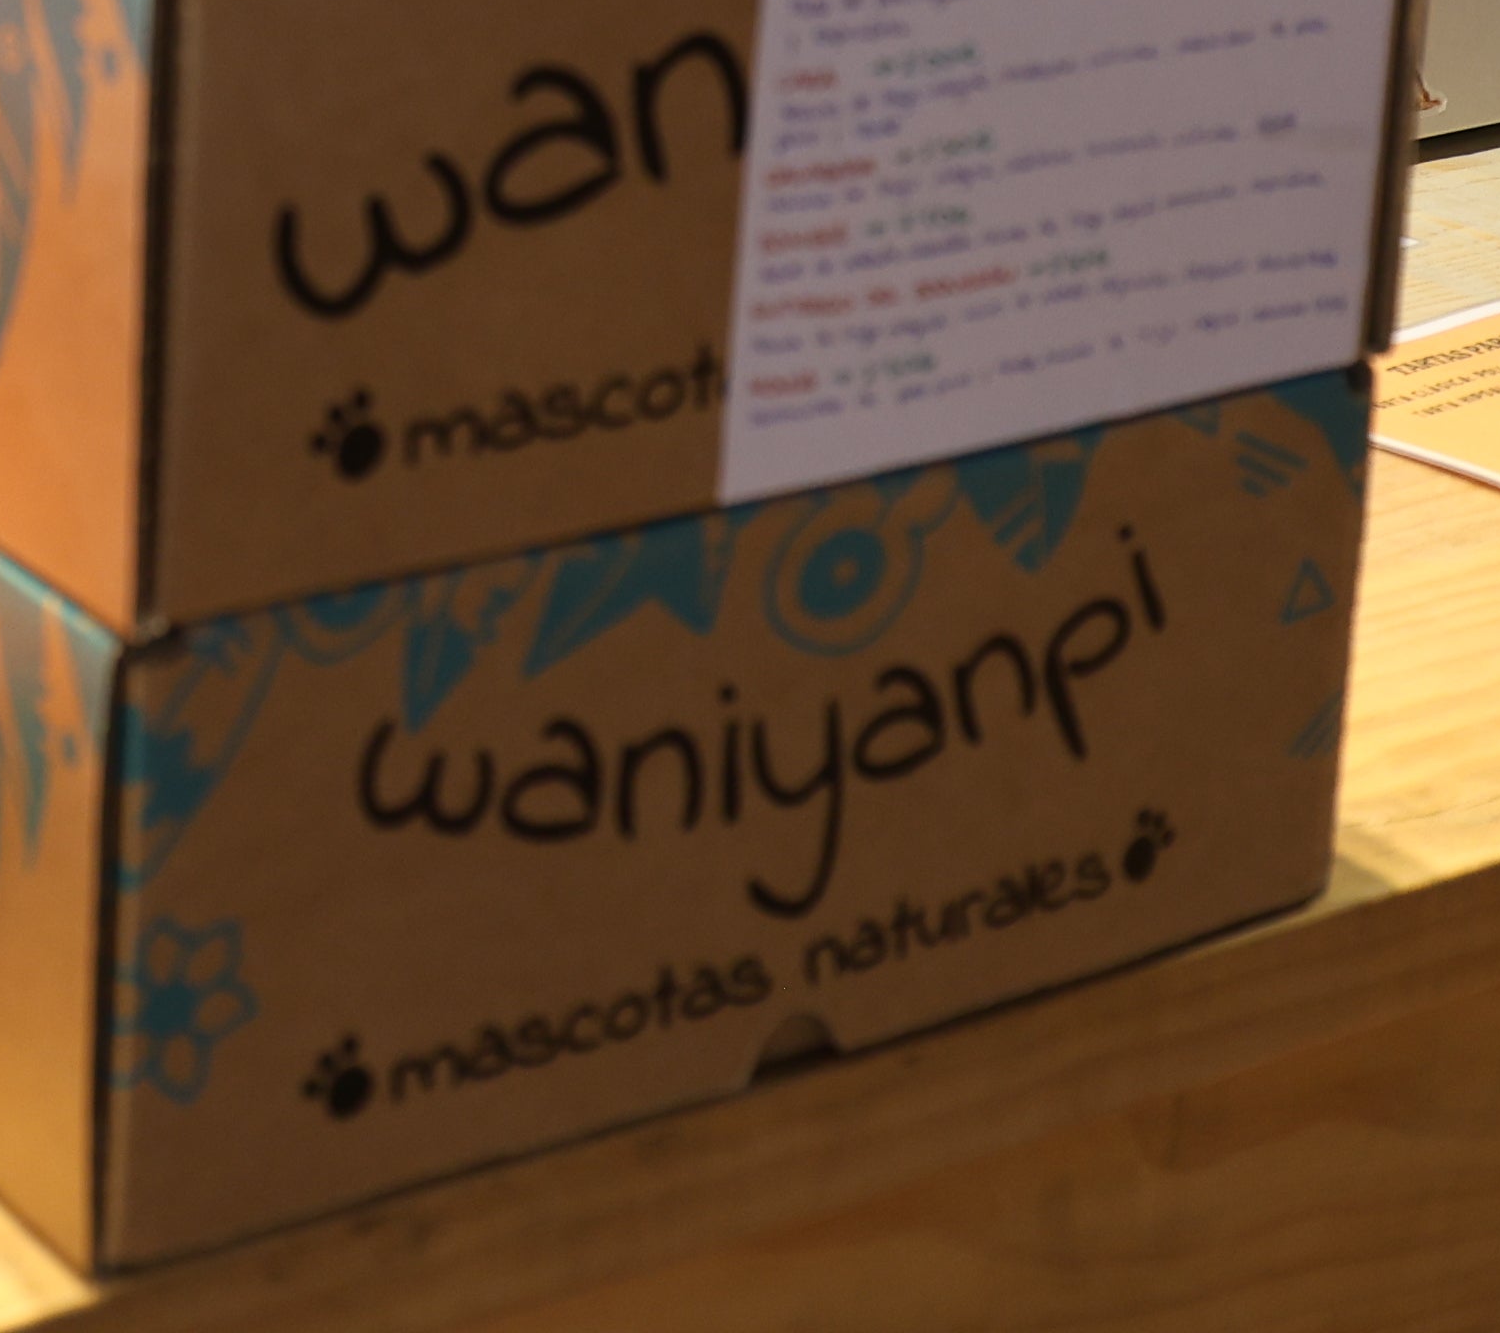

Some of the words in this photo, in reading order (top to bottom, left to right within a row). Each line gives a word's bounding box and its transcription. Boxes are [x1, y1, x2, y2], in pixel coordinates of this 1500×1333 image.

[272, 27, 753, 322] wan
[1373, 394, 1413, 410] ARTA
[1386, 345, 1472, 376] TARTAS
[356, 523, 1169, 920] waniyanpi
[387, 949, 776, 1105] mascotas
[803, 846, 1114, 989] naturales
